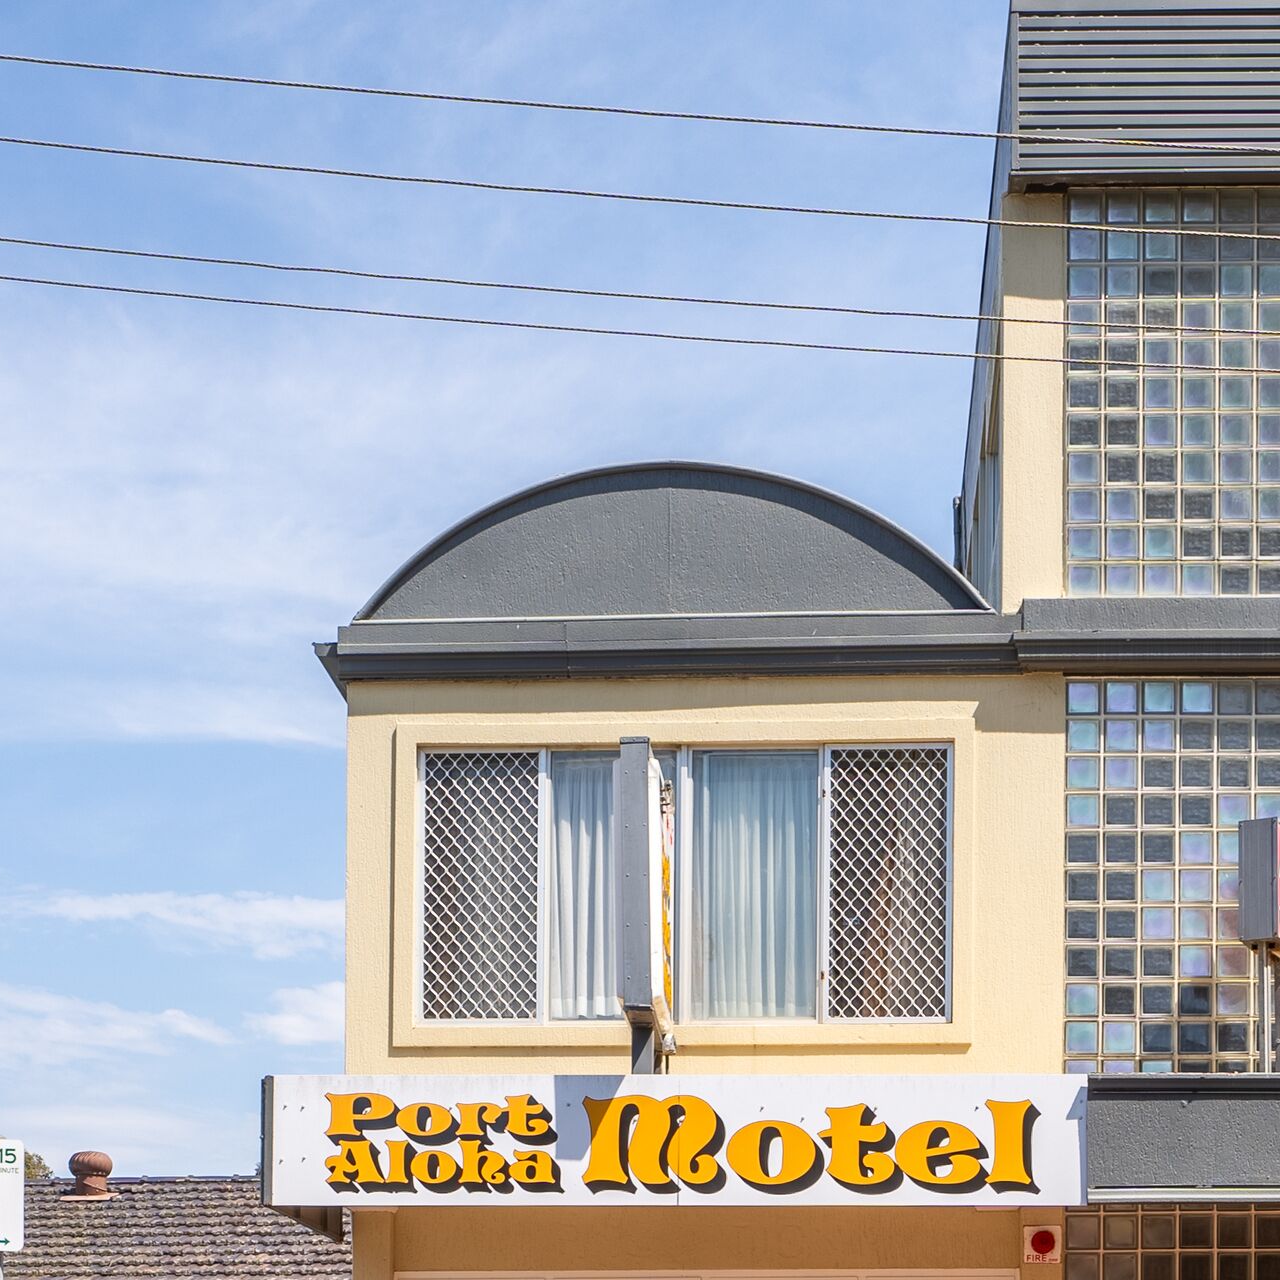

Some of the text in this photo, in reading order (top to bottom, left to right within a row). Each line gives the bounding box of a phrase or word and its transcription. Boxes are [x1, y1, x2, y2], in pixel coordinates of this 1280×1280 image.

[324, 1092, 558, 1144] Port
[582, 1094, 1041, 1195] Motel
[325, 1139, 564, 1193] Aloha
